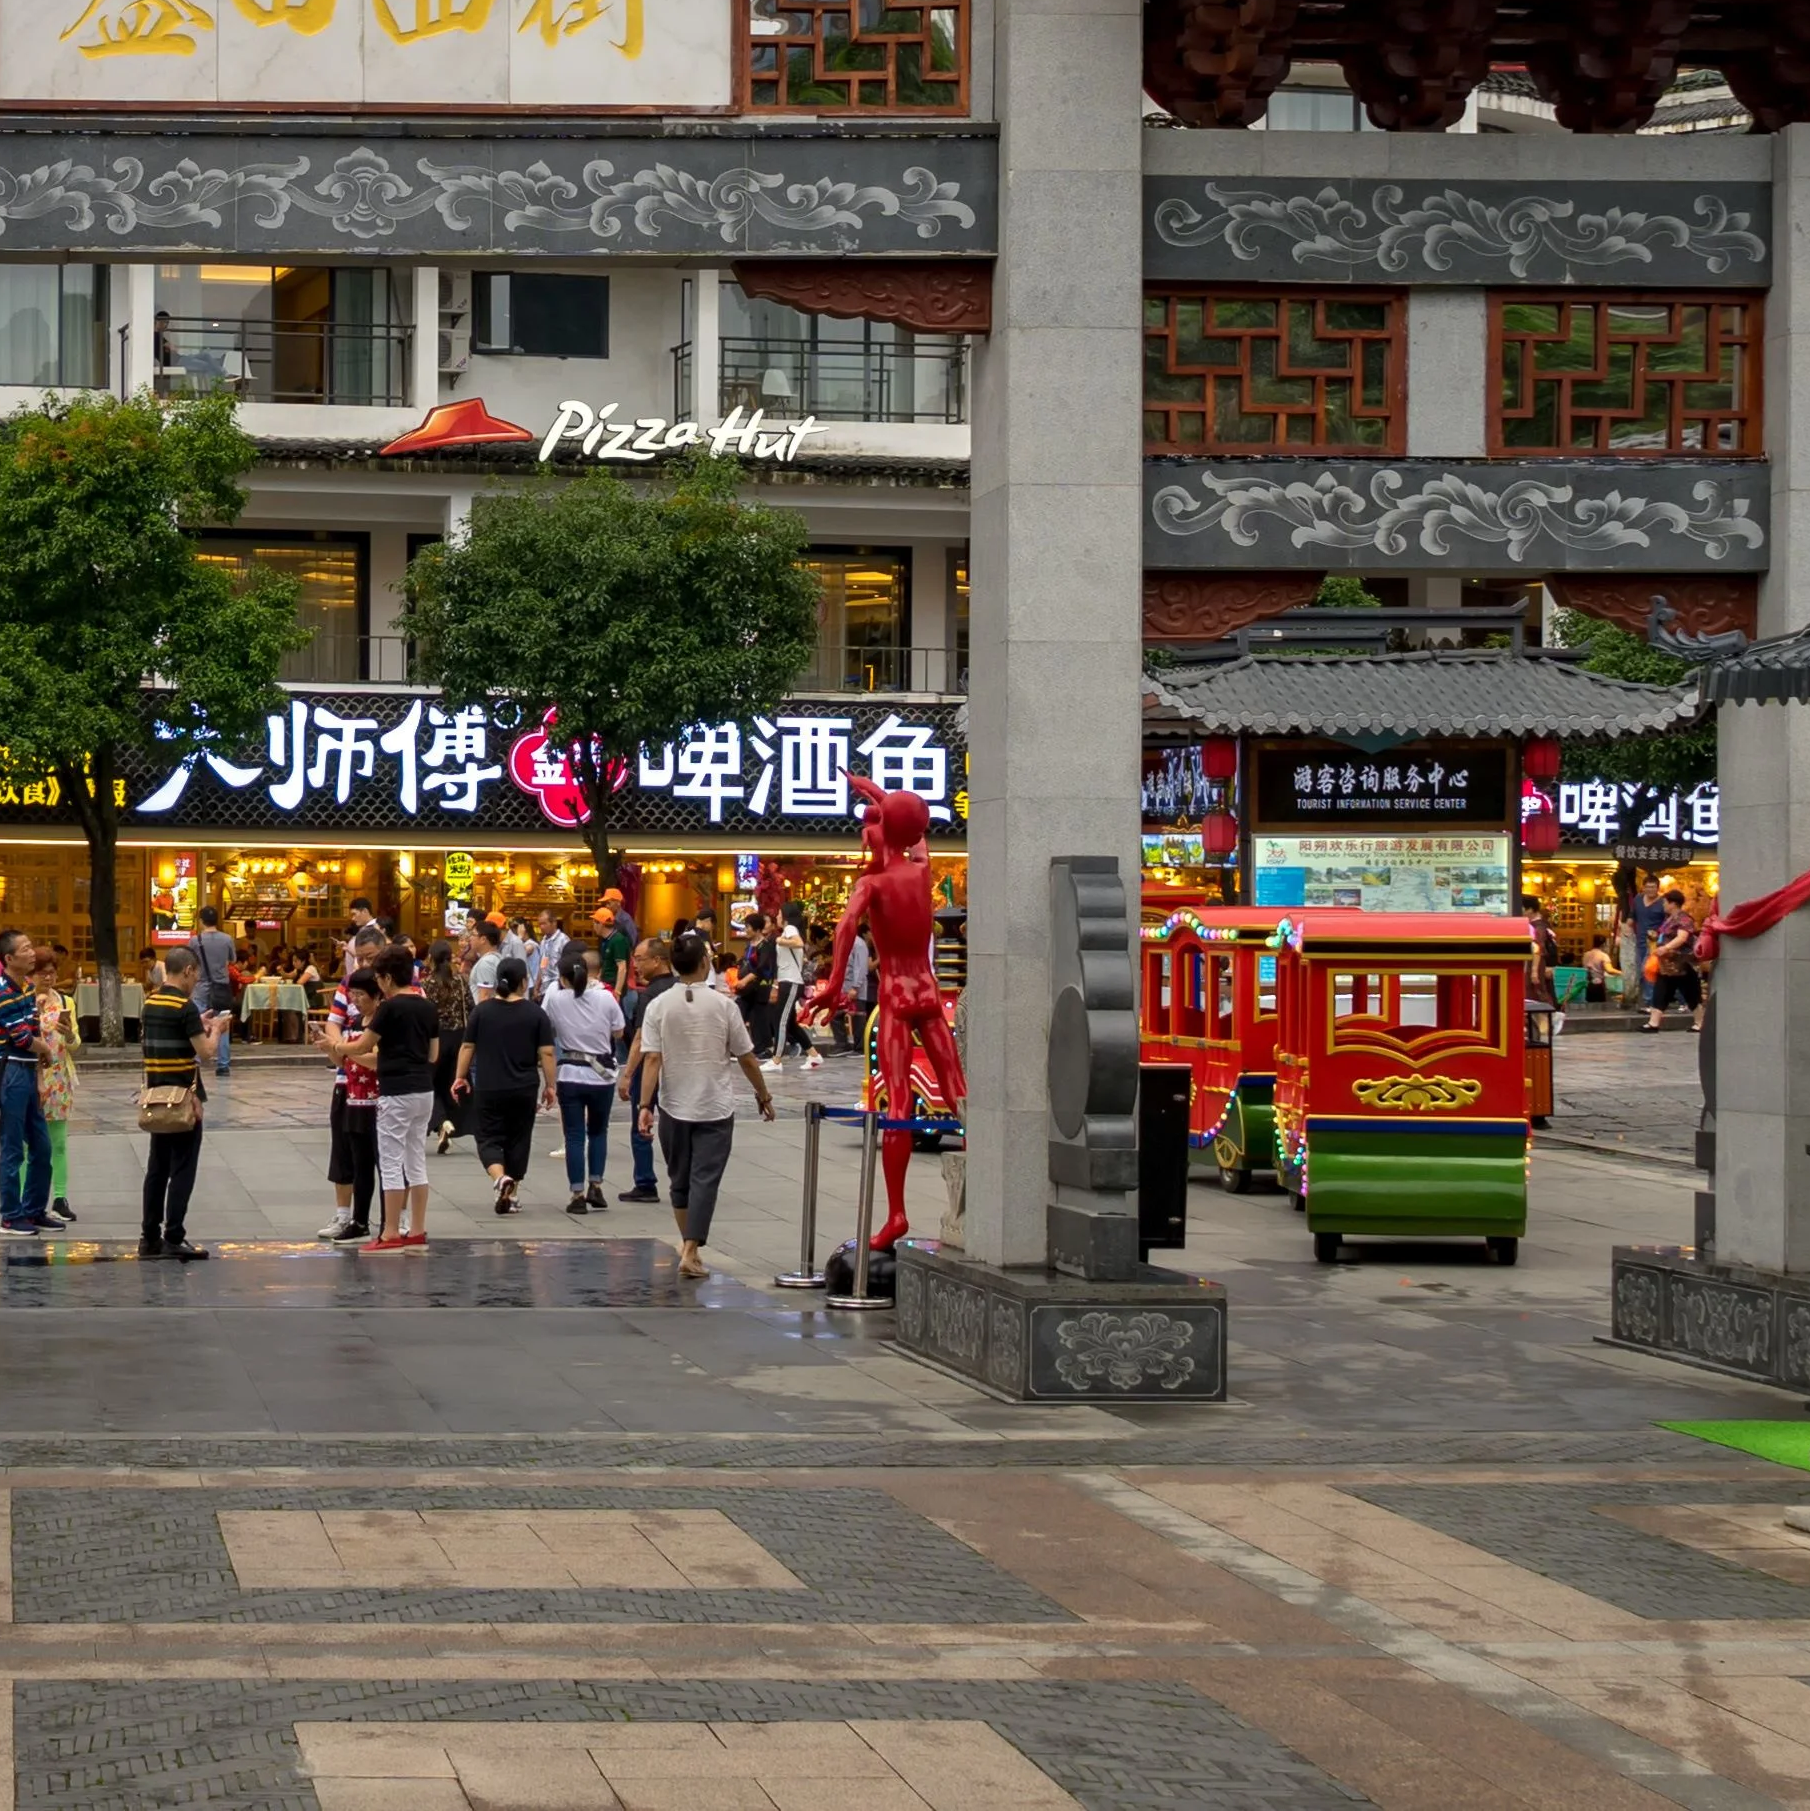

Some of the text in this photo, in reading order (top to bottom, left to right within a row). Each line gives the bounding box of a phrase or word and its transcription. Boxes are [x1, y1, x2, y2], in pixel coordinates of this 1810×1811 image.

[538, 399, 830, 462] Pizza Hut
[1293, 762, 1469, 795] 游客咨询服务中心
[1296, 799, 1468, 809] TOURIST INFORMATION SERVICE CENTER
[1299, 839, 1495, 853] 阳朔欢乐行旅游发展有限公司
